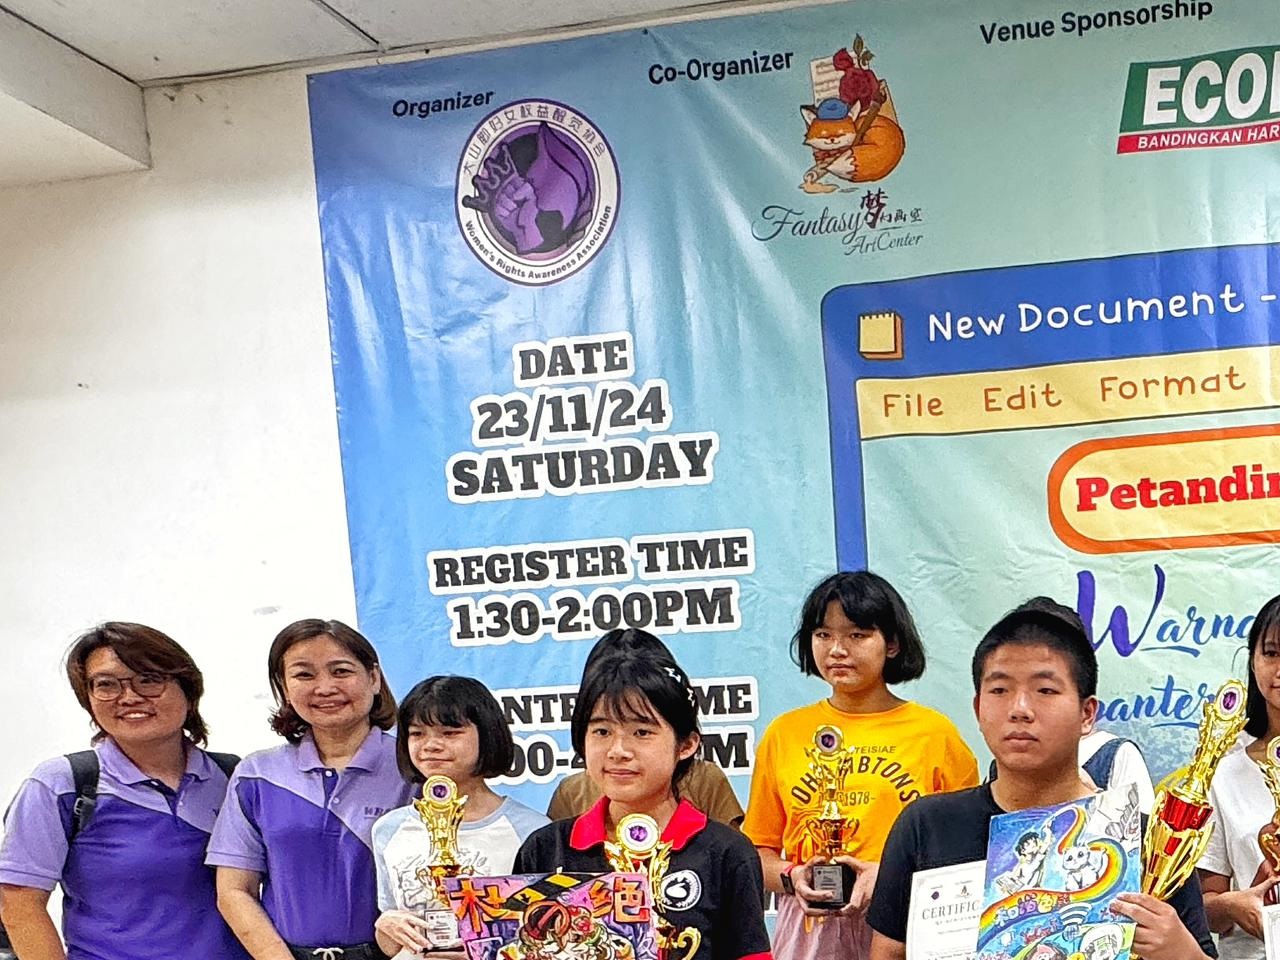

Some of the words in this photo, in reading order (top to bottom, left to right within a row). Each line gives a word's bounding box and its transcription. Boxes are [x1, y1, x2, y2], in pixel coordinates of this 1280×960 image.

[980, 16, 1056, 46] Venue
[1060, 0, 1214, 39] Sponsorship
[648, 50, 795, 85] Co-Organizer
[391, 89, 495, 119] Organizer
[1137, 128, 1244, 150] BANDINGKAN
[465, 220, 495, 263] Women's
[495, 258, 527, 279] Rights
[528, 258, 577, 280] Awareness
[576, 204, 612, 262] Association
[751, 204, 863, 245] Fantasy
[928, 308, 1005, 343] New
[1018, 283, 1246, 334] Document
[518, 338, 628, 381] DATE
[477, 385, 666, 443] 23/11/24
[882, 391, 945, 419] File
[983, 382, 1063, 413] Edit
[1100, 364, 1248, 404] Format
[453, 438, 713, 498] SATURDAY
[433, 545, 628, 588] REGISTER
[637, 535, 749, 574] TIME
[454, 587, 735, 641] 1:30-2:00PM
[921, 900, 980, 920] CERTIFIC
